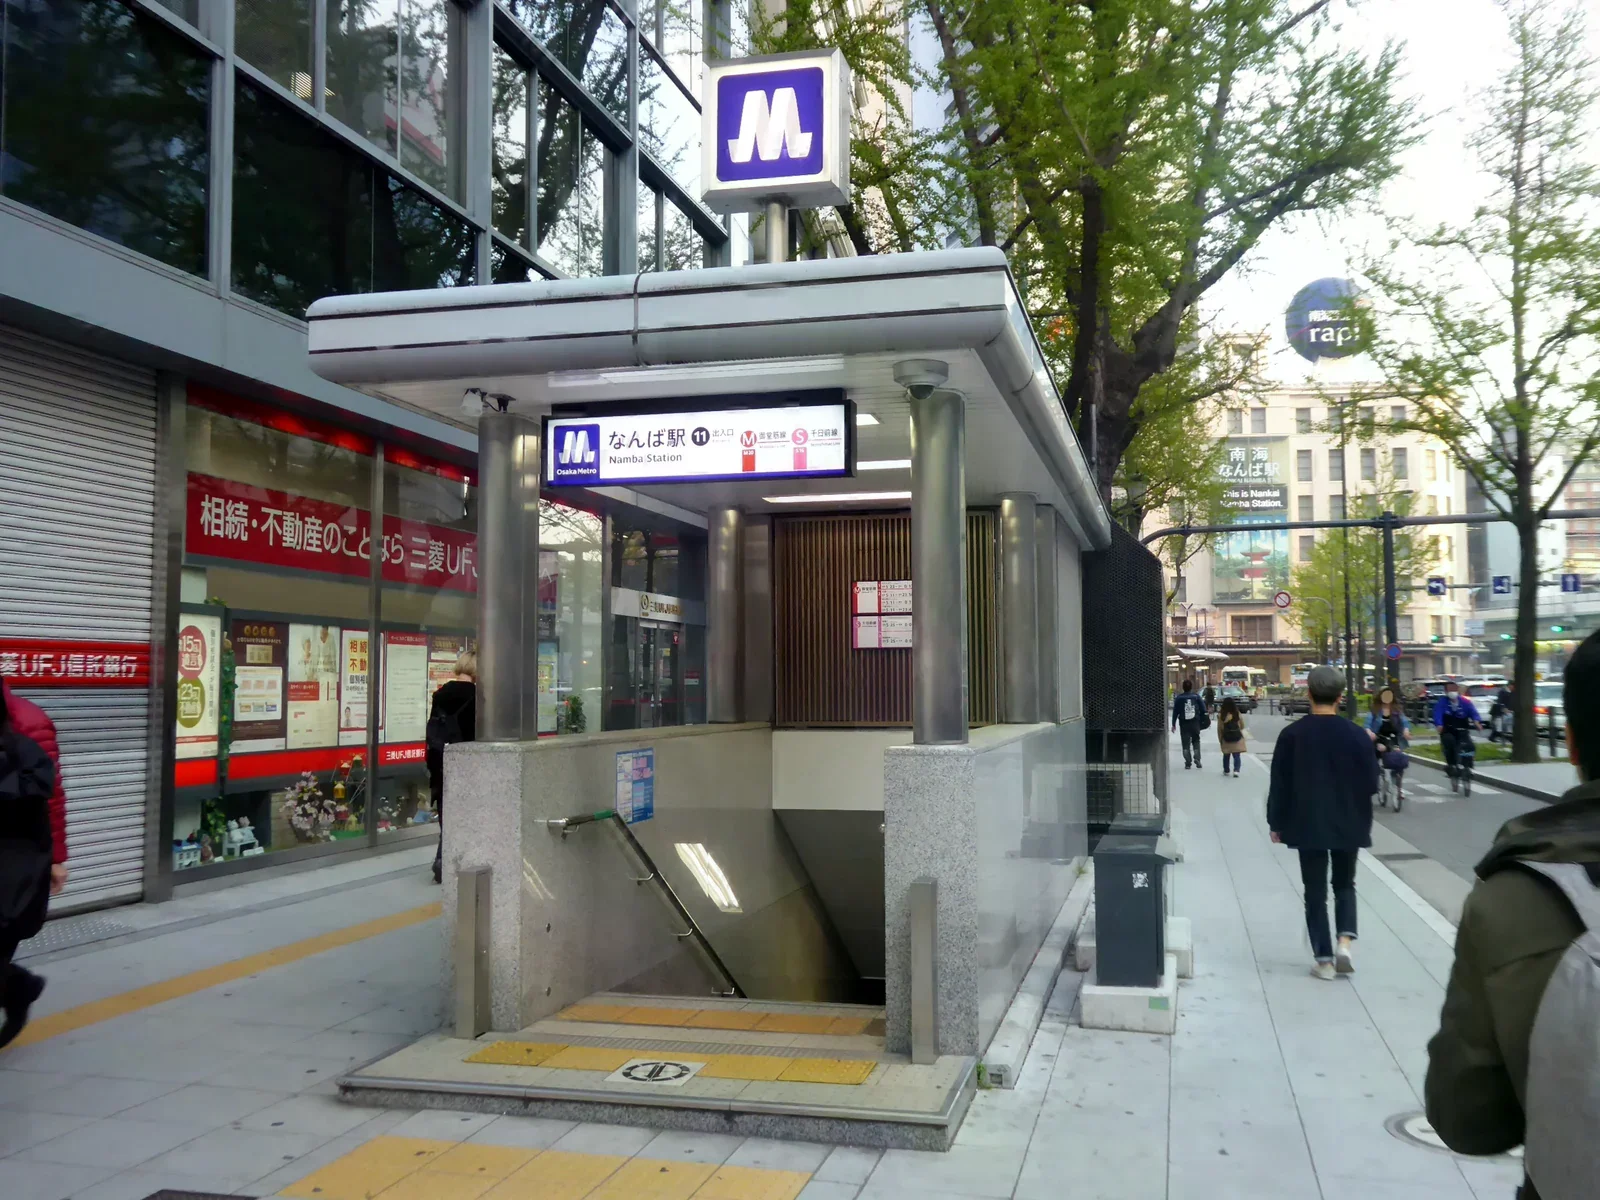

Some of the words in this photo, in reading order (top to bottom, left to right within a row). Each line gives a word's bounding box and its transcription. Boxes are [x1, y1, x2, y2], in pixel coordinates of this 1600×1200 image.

[608, 427, 686, 450] なんば駅
[693, 430, 707, 443] 11
[711, 428, 734, 437] 出入口
[609, 454, 644, 465] Namba
[646, 453, 682, 463] Station
[556, 468, 577, 476] Osaka
[577, 467, 597, 475] Metro
[1218, 462, 1280, 478] なんば駅
[1241, 489, 1249, 498] is
[1250, 488, 1280, 498] Nankai
[350, 640, 368, 653] 相続
